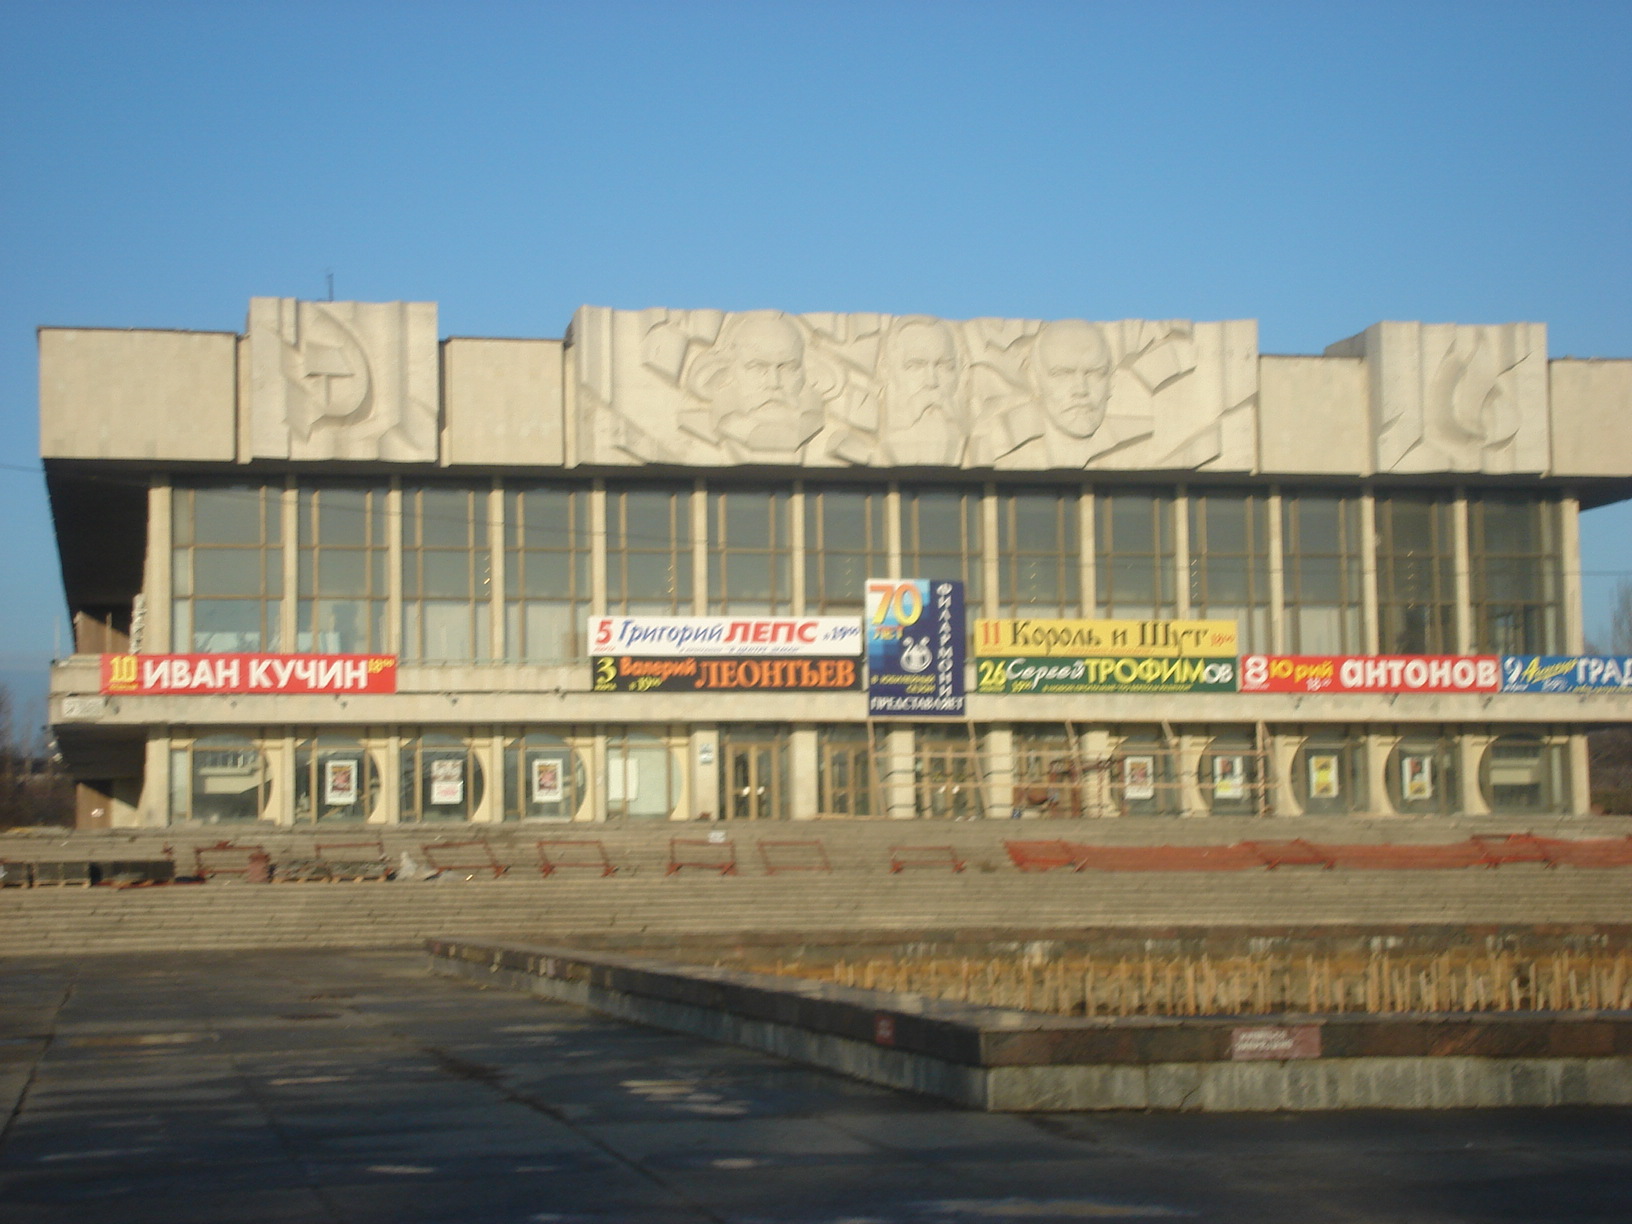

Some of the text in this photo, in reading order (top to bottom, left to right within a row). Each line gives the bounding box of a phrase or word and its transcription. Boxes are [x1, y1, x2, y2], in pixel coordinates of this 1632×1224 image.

[869, 582, 923, 627] 70
[595, 620, 613, 644] 5
[618, 620, 724, 647] Григорий
[723, 621, 819, 643] ЛЕПС
[982, 622, 1000, 645] 11
[1011, 621, 1101, 656] Король
[1112, 628, 1128, 646] и
[1137, 621, 1209, 657] Шут
[109, 655, 138, 682] 10
[143, 659, 240, 689] ИВАН
[248, 658, 368, 689] КУЧИН
[597, 657, 856, 688] 3 Валерий ЛЕОНТЬЕВ
[978, 659, 1007, 686] 26
[1006, 658, 1086, 690] Сергей
[1244, 655, 1269, 685] 8
[1269, 659, 1334, 683] Юрий
[1504, 656, 1523, 684] 9
